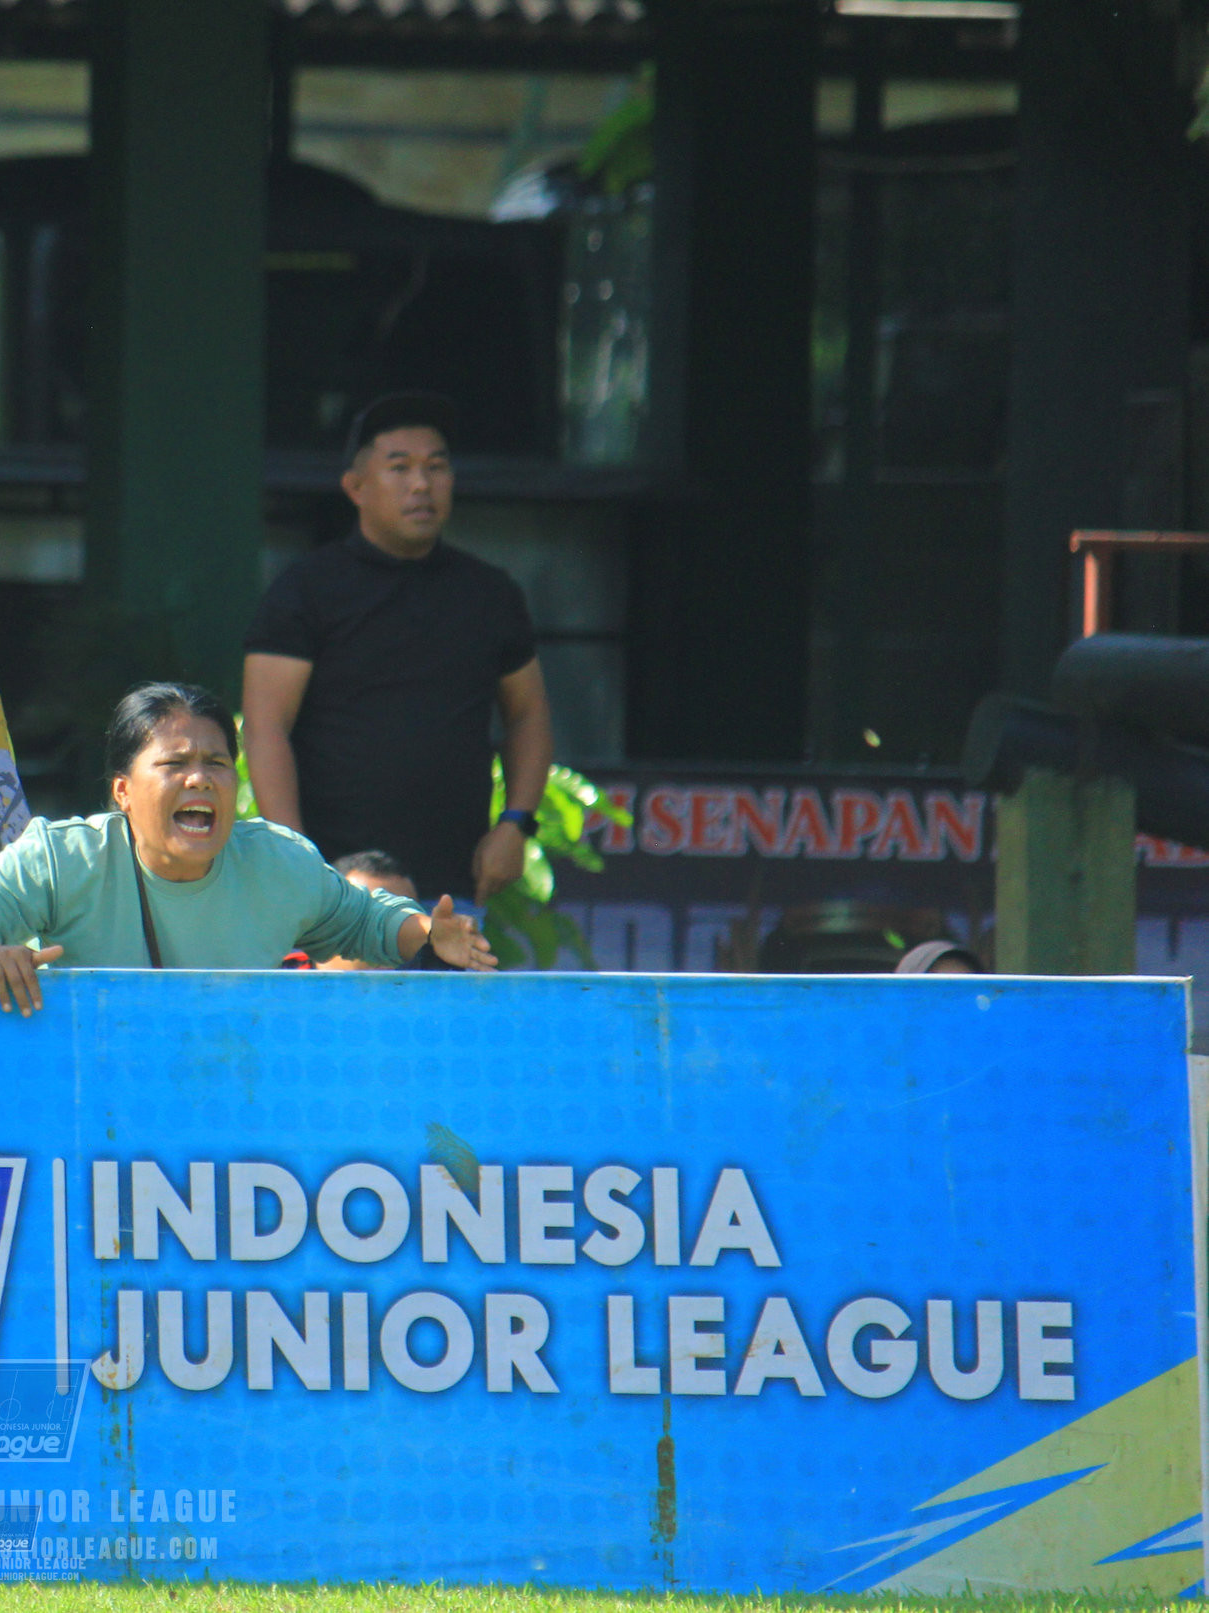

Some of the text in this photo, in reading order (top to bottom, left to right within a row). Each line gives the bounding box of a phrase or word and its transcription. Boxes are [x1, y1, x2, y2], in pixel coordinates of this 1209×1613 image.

[642, 785, 987, 862] SENAPAN
[92, 1160, 782, 1268] INDONESIA
[90, 1289, 1076, 1401] JUNIOR LEAGUE
